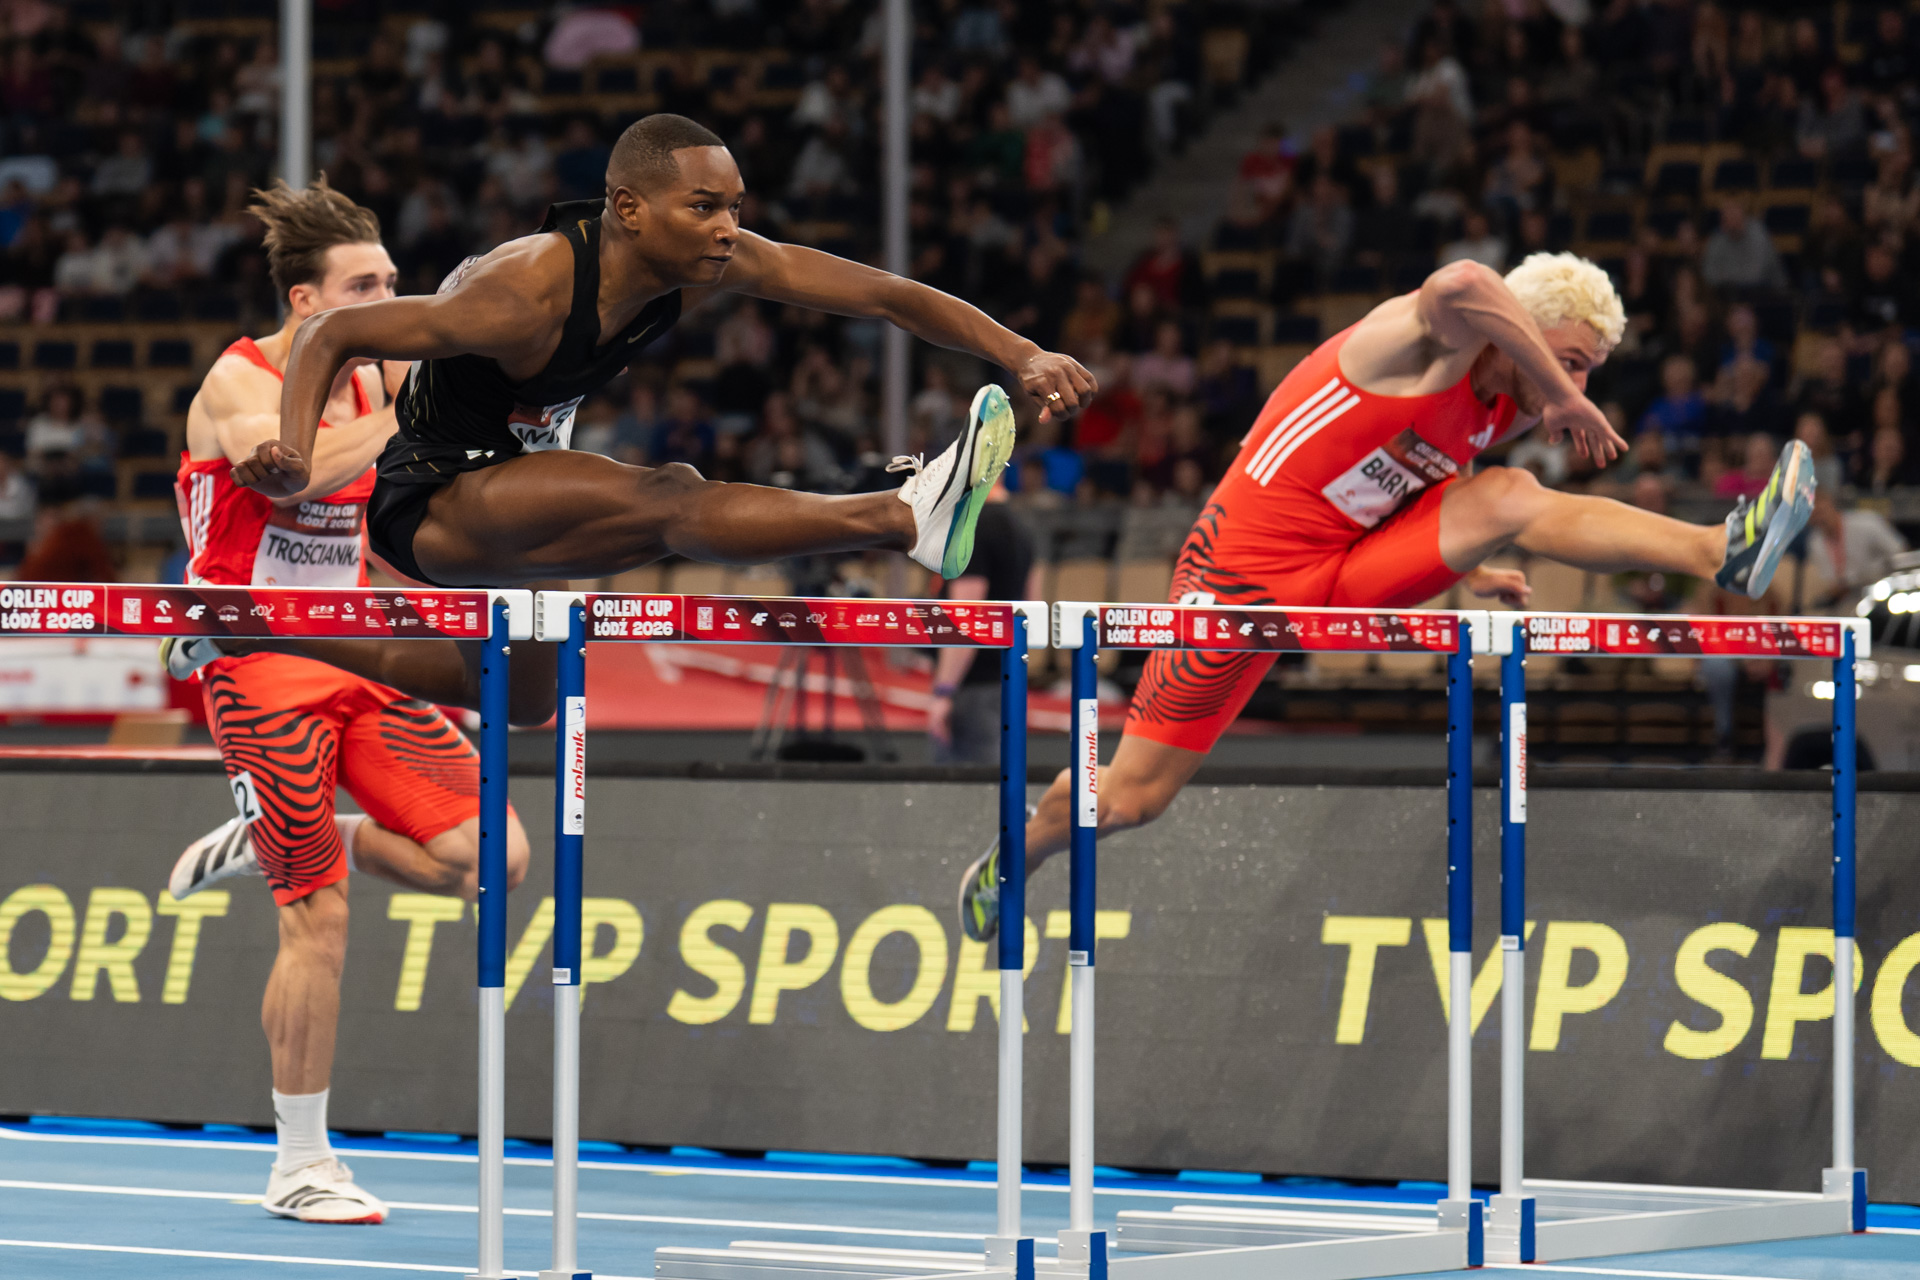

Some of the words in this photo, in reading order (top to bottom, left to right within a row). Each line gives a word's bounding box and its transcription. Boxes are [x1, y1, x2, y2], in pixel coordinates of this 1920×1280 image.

[299, 501, 341, 517] ORLEN
[0, 589, 57, 609] ORLEN
[61, 590, 95, 609] CUP
[592, 600, 642, 617] ORLEN
[645, 600, 673, 617] CUP
[1, 609, 41, 629] ŁÓDŹ
[46, 612, 95, 629] 2026
[593, 617, 628, 635] ŁÓDŹ
[632, 621, 673, 636] 2026
[1105, 609, 1147, 626] ORLEN
[1150, 610, 1174, 626] CUP
[1529, 618, 1566, 634] ORLEN
[1568, 619, 1590, 634] CUP
[1106, 626, 1136, 643] ŁÓDŹ
[1139, 629, 1174, 644] 2026
[571, 730, 584, 800] polanik
[1085, 731, 1097, 795] polanik
[234, 781, 255, 820] 2
[0, 882, 230, 1004] ORT
[387, 892, 644, 1016] TVP
[666, 899, 1132, 1034] SPORT
[1321, 915, 1630, 1052] TVP
